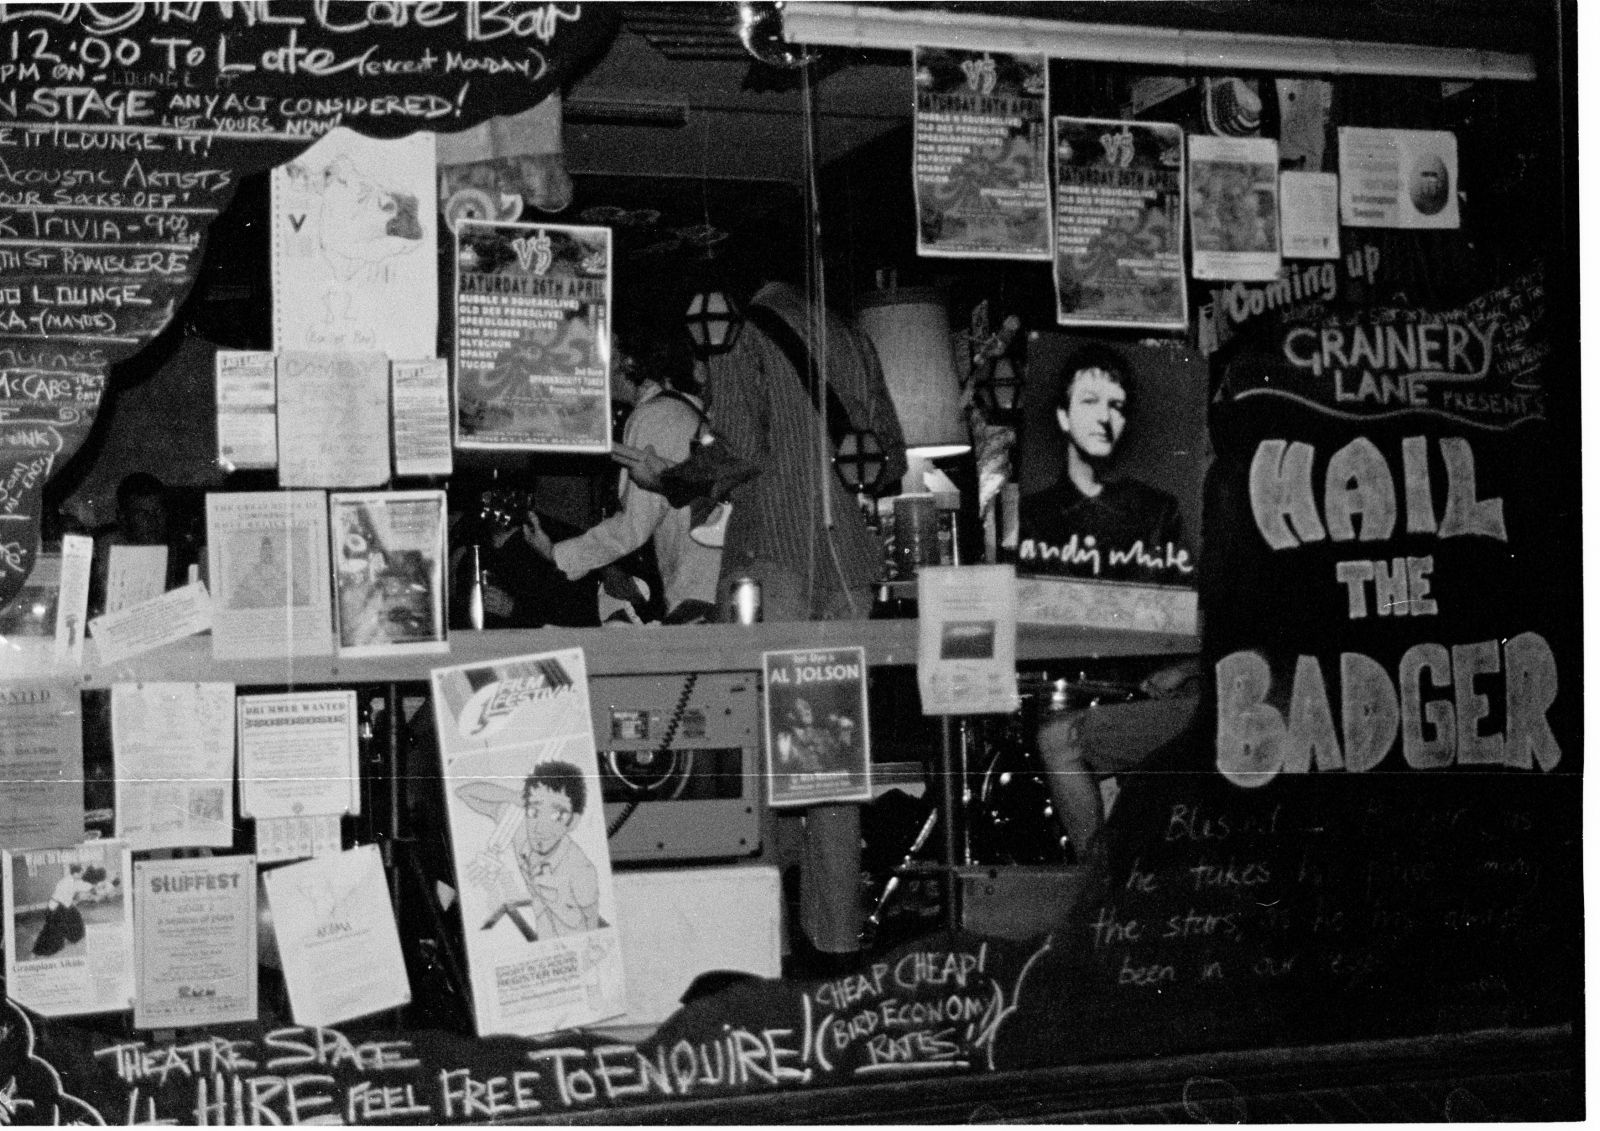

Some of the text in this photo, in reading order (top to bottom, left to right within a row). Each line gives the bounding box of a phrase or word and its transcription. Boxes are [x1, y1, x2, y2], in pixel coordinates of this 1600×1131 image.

[217, 28, 340, 76] Late
[25, 86, 157, 126] STAGE
[213, 116, 275, 135] YOURS
[64, 131, 165, 151] LOUNGE
[1347, 245, 1380, 285] up
[31, 284, 153, 308] LOUNGE
[1283, 320, 1498, 378] GRAINERY
[1333, 369, 1430, 405] LANE
[1248, 435, 1508, 551] HAIL
[1336, 555, 1439, 620] THE
[770, 663, 860, 685] AL JOLSON
[1215, 631, 1562, 788] BADGER
[93, 1026, 421, 1086] THEATRE SPACE
[348, 1080, 431, 1123] FEEL
[439, 1068, 541, 1118] FREE
